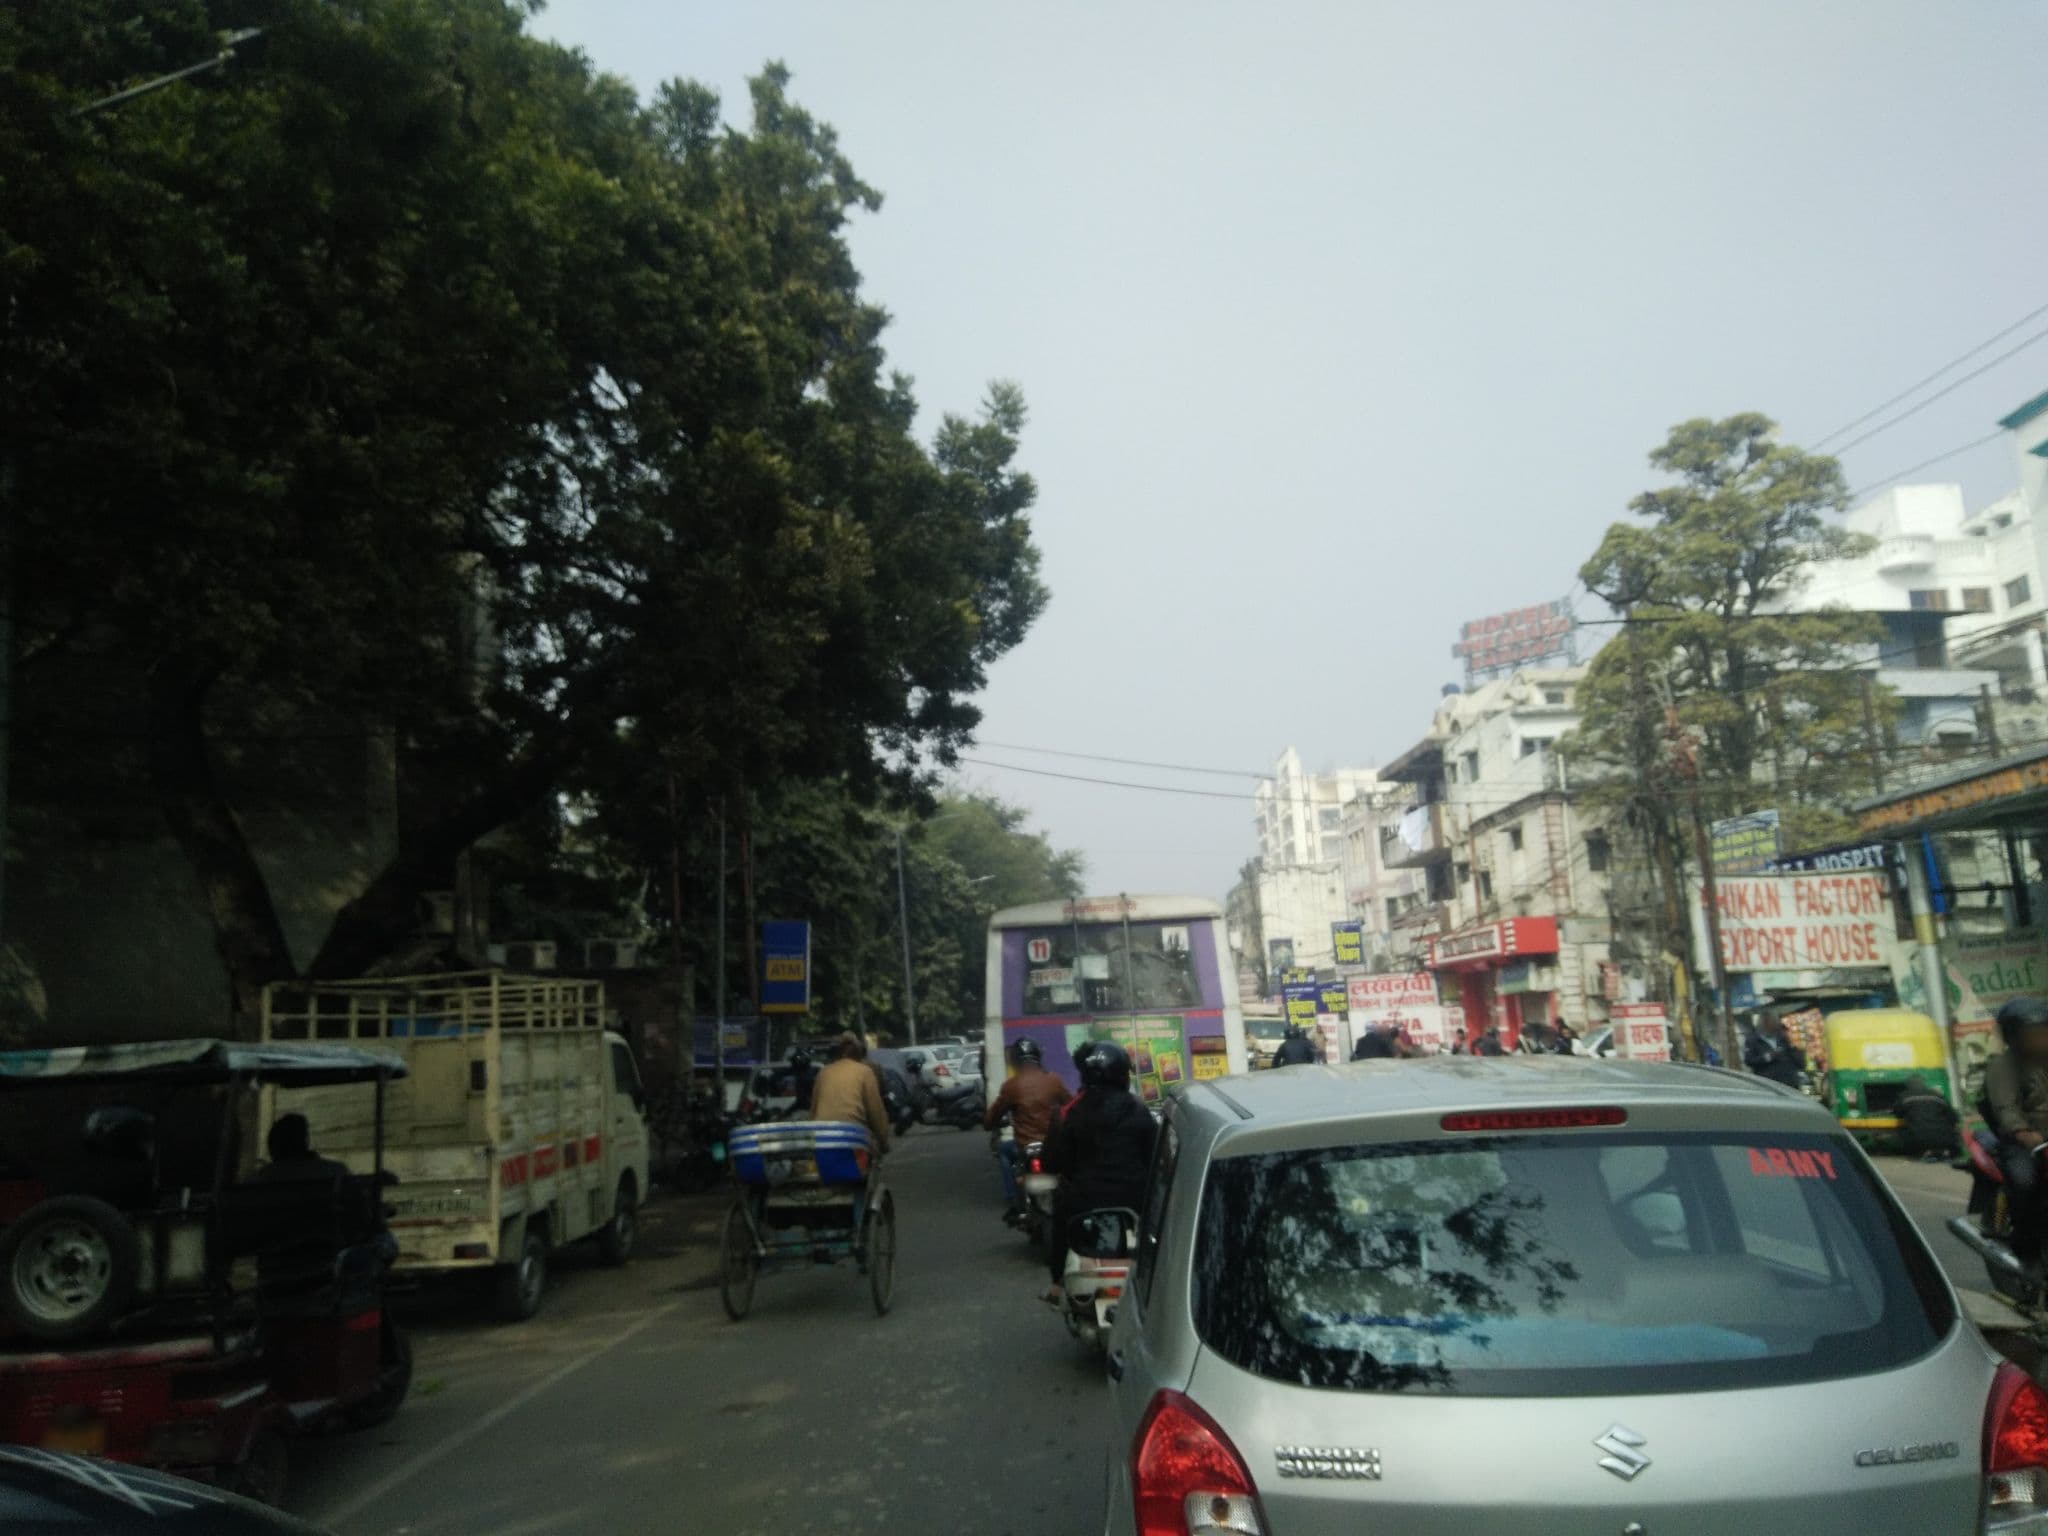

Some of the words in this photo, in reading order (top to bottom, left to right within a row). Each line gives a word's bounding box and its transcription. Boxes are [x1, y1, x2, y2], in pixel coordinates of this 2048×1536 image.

[1793, 874, 1888, 917] FACTORY
[1031, 940, 1048, 961] 11
[1720, 926, 1797, 966] EXPORT
[1804, 922, 1880, 963] HOUSE
[770, 963, 801, 977] ATM
[1747, 1146, 1838, 1181] ARMY
[1277, 1460, 1383, 1480] SUZUKI
